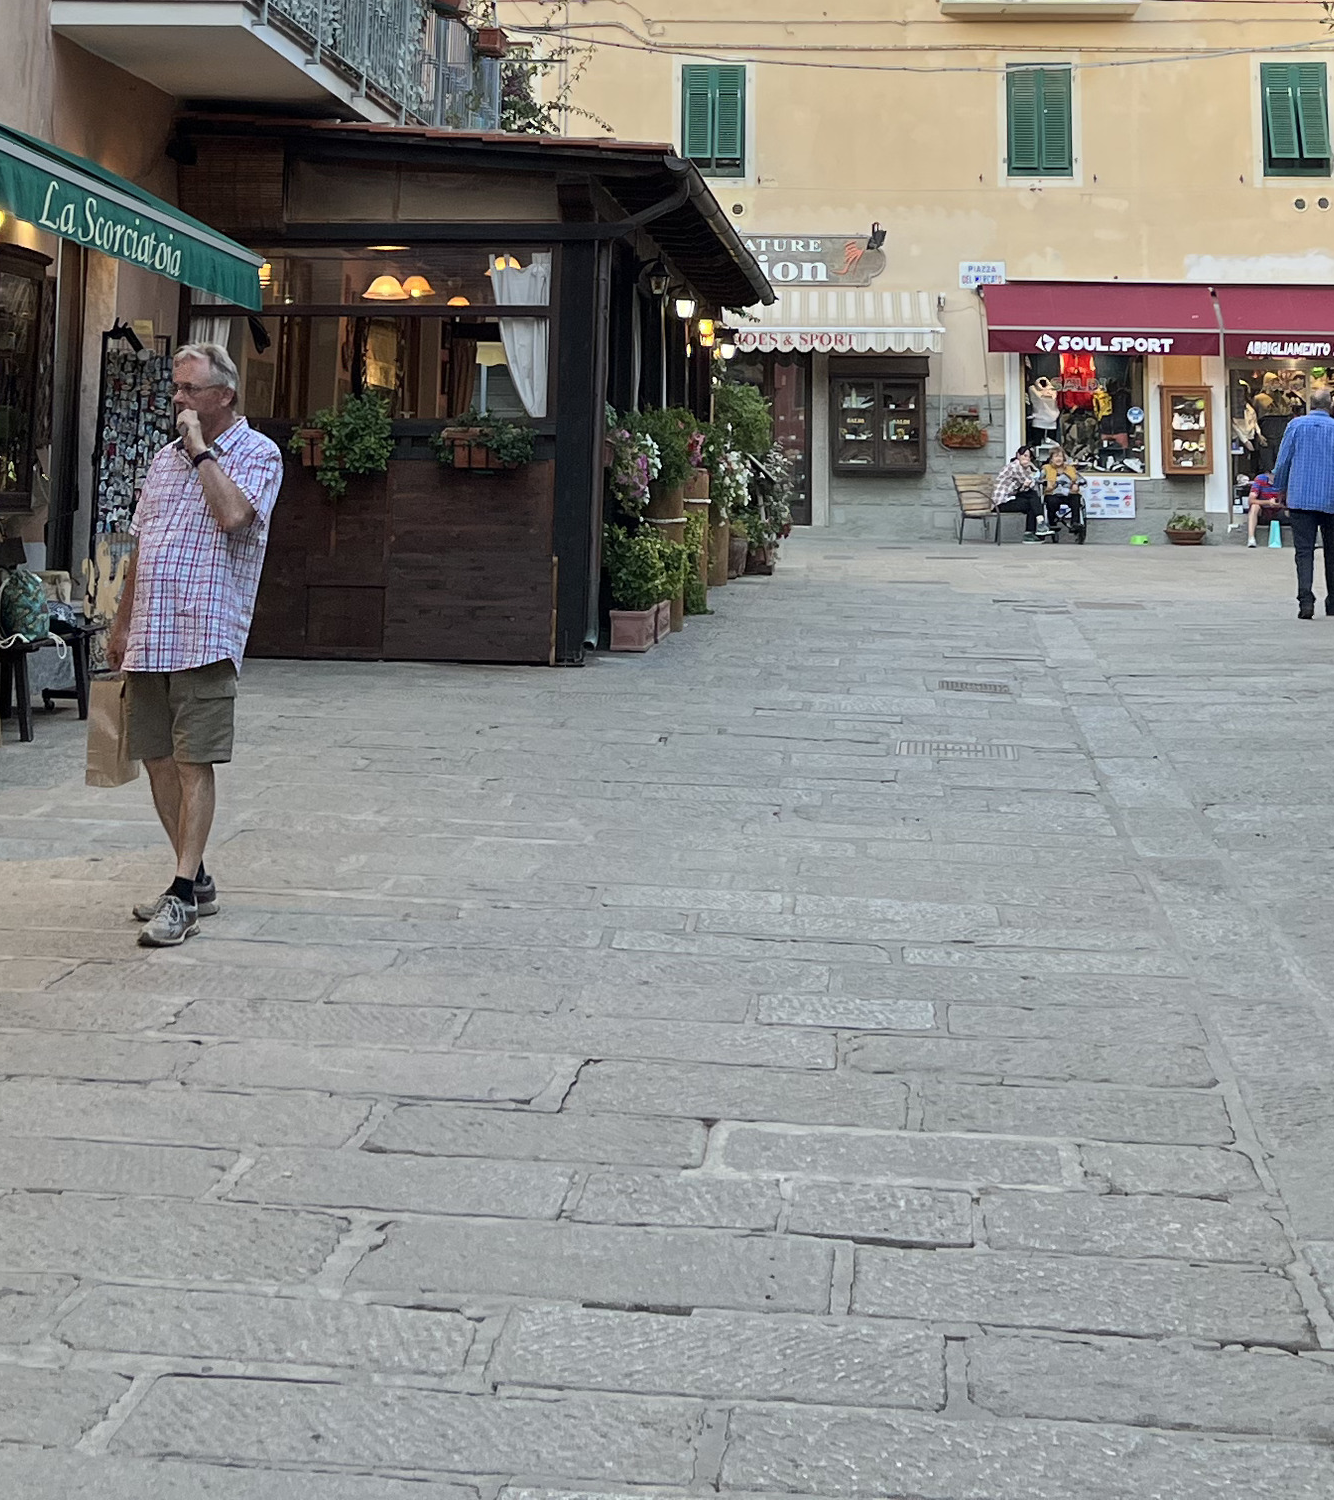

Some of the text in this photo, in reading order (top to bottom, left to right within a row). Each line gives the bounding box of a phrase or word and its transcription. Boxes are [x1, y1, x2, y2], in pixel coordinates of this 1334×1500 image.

[38, 181, 182, 277] La Scorciatoia
[968, 265, 996, 273] PIAZZA
[799, 333, 855, 347] SPORT
[1246, 341, 1331, 356] ABBIGLIAMENTO
